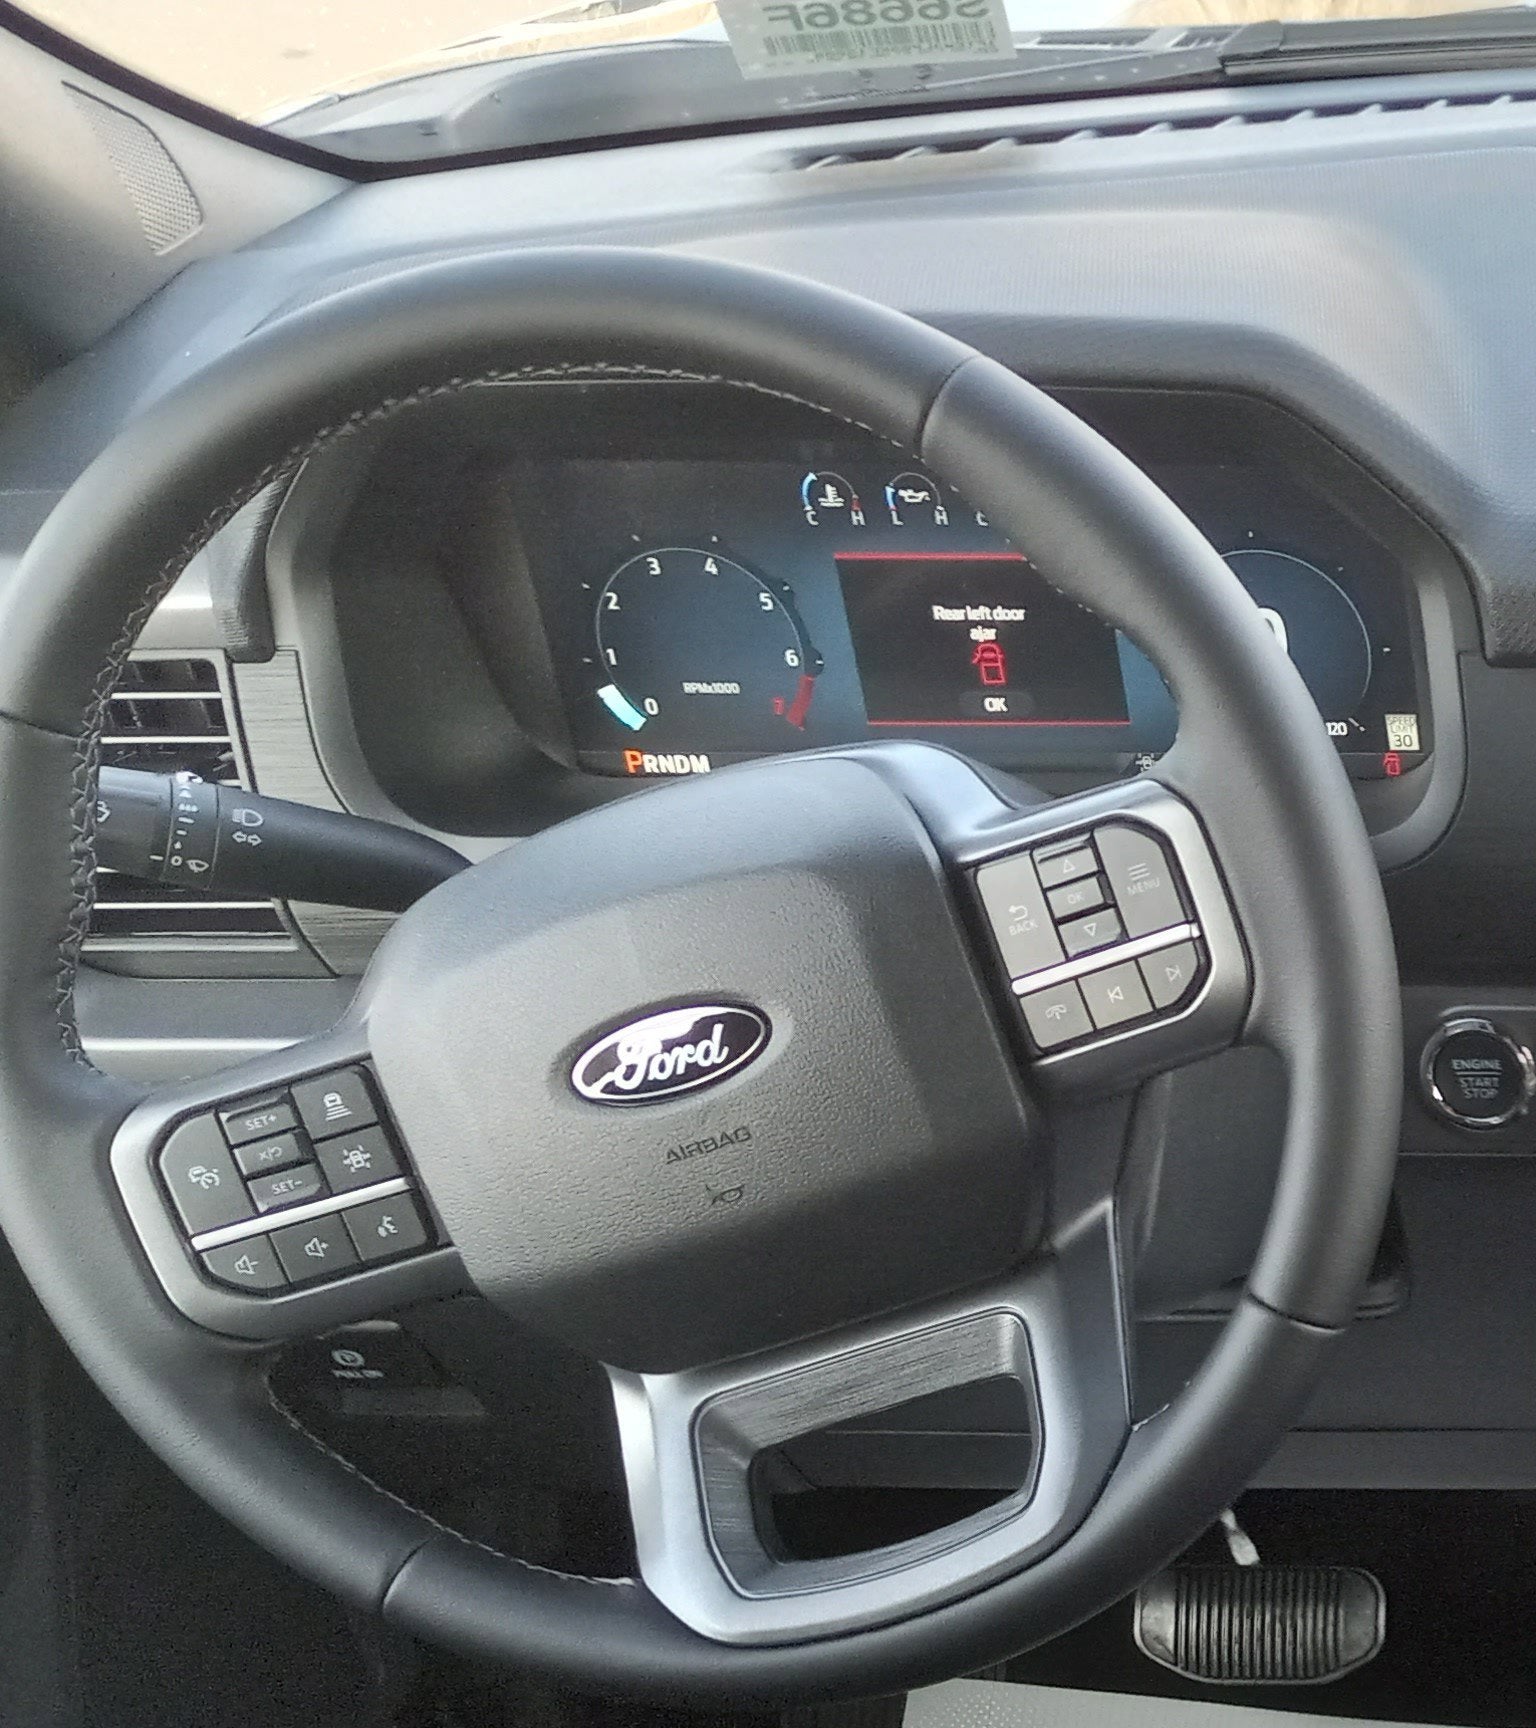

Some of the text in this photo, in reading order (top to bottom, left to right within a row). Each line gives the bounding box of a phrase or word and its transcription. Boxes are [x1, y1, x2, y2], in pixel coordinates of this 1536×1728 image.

[806, 510, 819, 525] C
[851, 510, 866, 526] H
[891, 510, 904, 526] L
[934, 510, 949, 526] H
[646, 557, 662, 575] 3
[704, 557, 719, 576] 4
[605, 592, 621, 610] 2
[759, 592, 774, 611] 5
[932, 605, 1026, 621] Rear left door
[970, 625, 997, 642] ajar
[605, 648, 618, 666] 1
[784, 649, 799, 667] 6
[643, 697, 659, 716] 0
[984, 697, 1008, 712] OK
[1325, 721, 1348, 736] 120
[1393, 734, 1413, 748] 30
[1127, 878, 1161, 896] MENU
[1067, 892, 1086, 905] OK
[1008, 919, 1039, 936] BACK
[616, 1023, 729, 1090] Ford
[1451, 1059, 1503, 1070] ENGINE
[1460, 1077, 1499, 1088] START
[1464, 1088, 1499, 1099] STOP
[245, 1114, 277, 1131] SET+
[666, 1126, 752, 1165] AIRBAG
[271, 1179, 303, 1195] SET-
